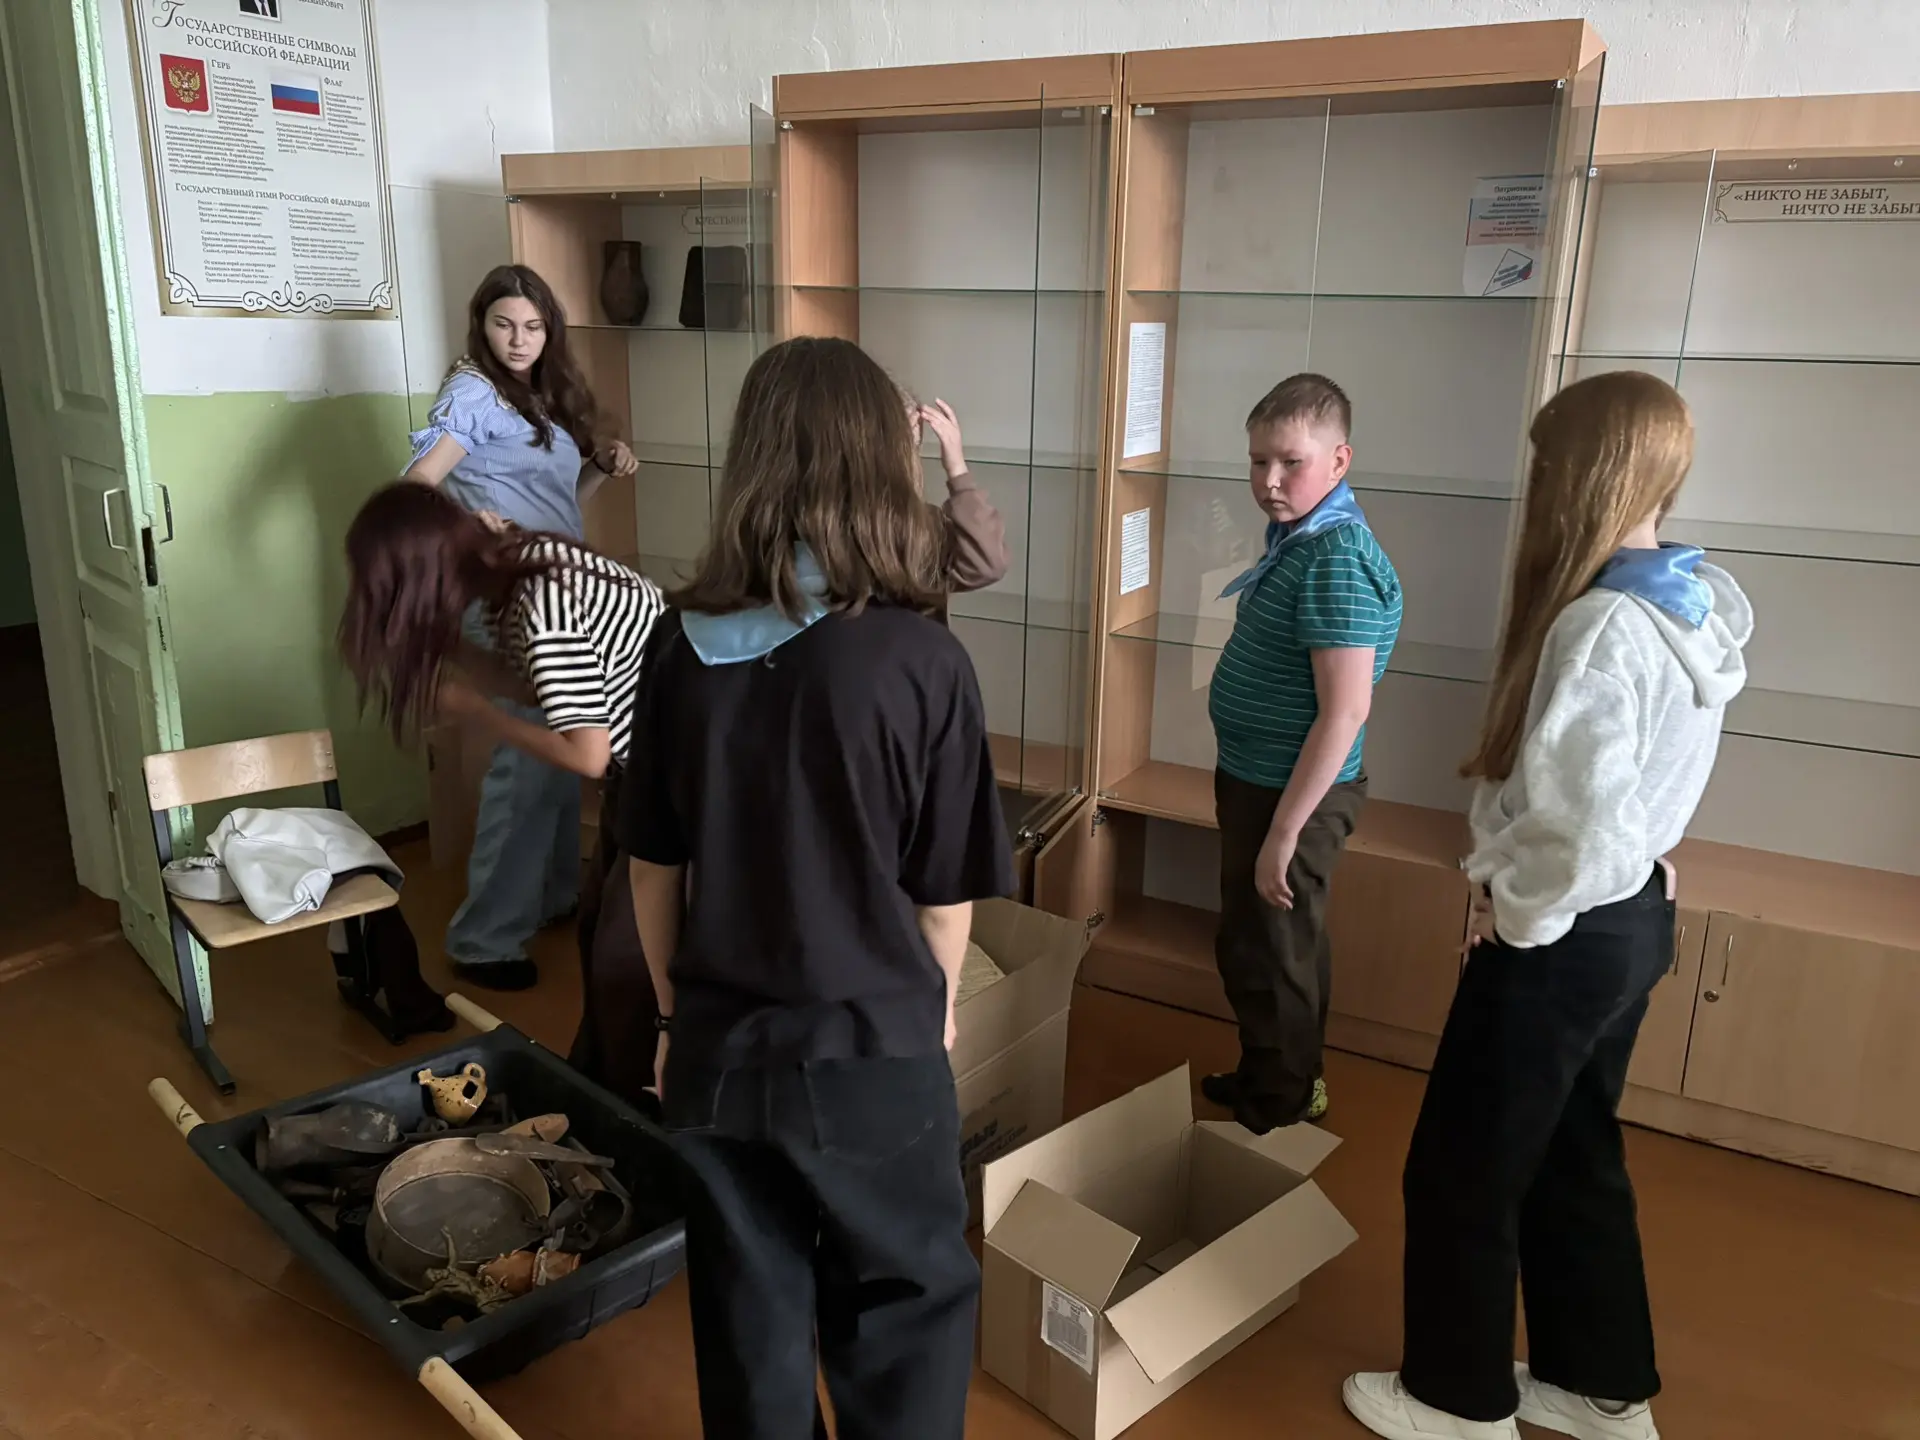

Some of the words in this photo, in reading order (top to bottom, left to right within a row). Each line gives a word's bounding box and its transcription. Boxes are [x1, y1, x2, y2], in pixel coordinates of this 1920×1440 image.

[187, 33, 277, 59] РОССИЙСКОЙ
[280, 49, 350, 71] ФЕДЕРАЦИИ
[297, 37, 357, 57] СИМВОЛЫ
[174, 182, 254, 198] ГОСУДАРСТВЕННЫЙ
[1734, 189, 1801, 201] «НИКТО
[1805, 188, 1828, 200] НЕ
[1830, 188, 1889, 201] ЗАБЫТ,
[1782, 203, 1840, 215] НИЧТО
[1843, 203, 1867, 214] НЕ
